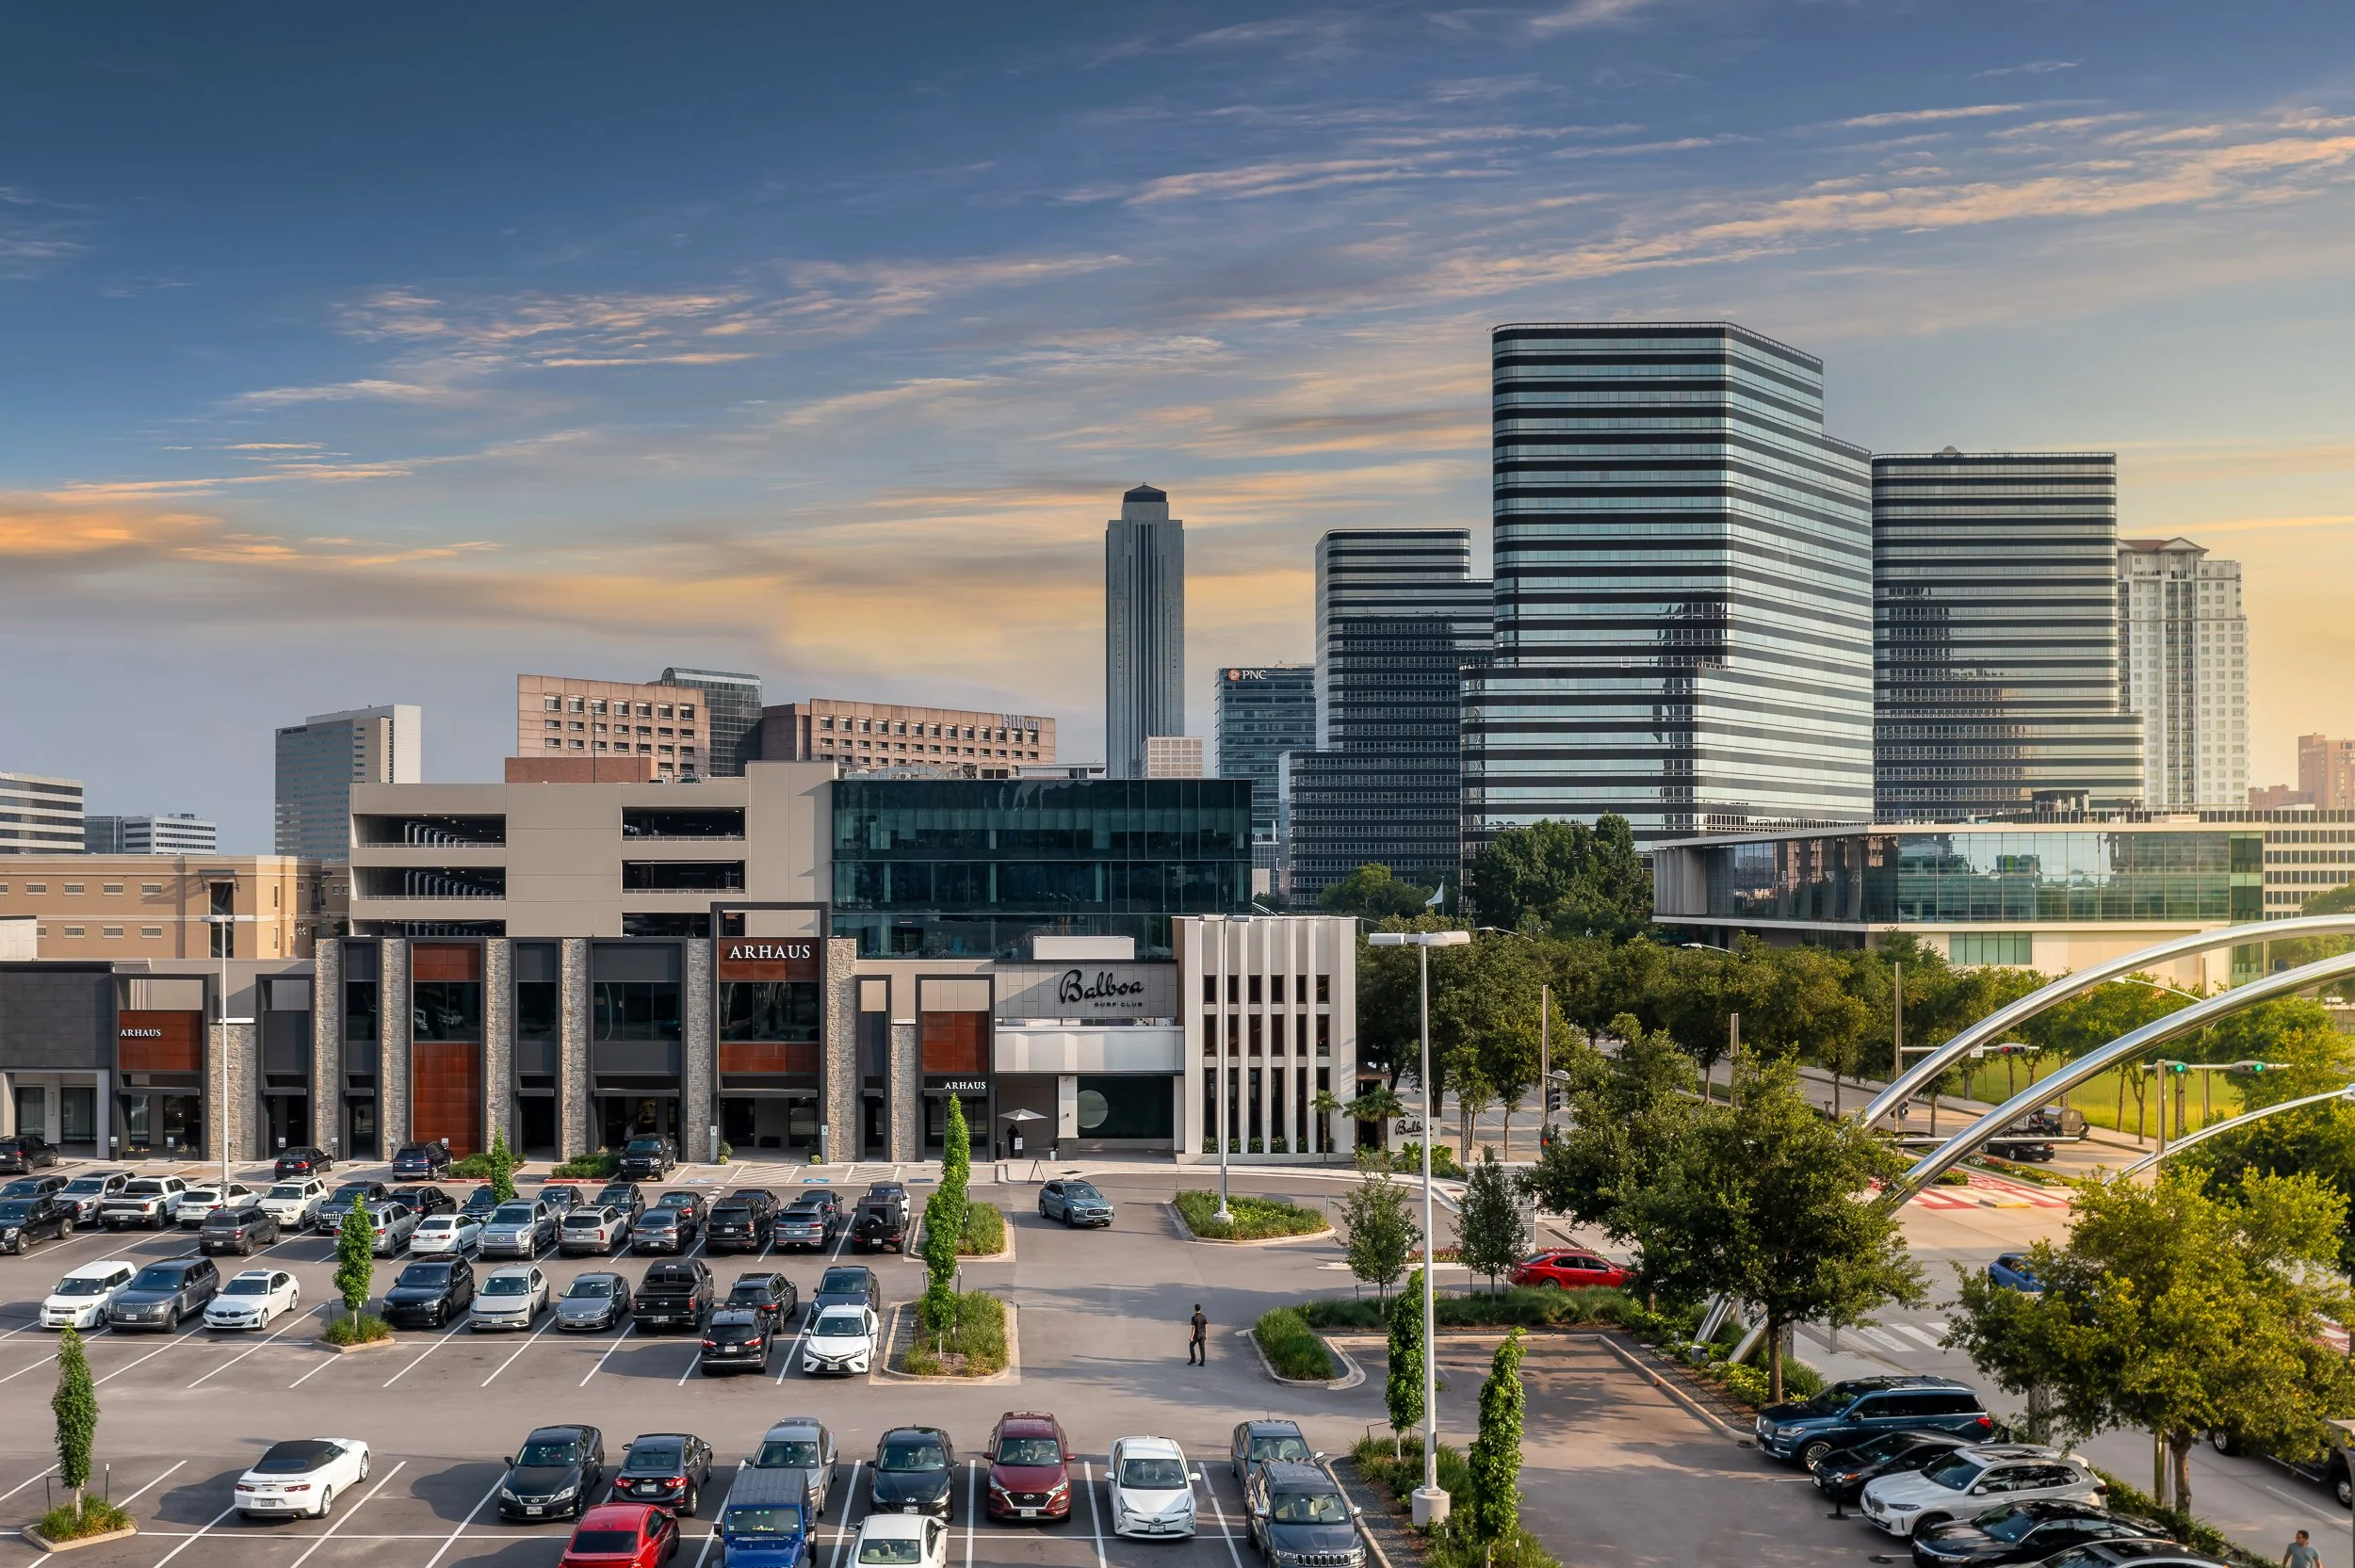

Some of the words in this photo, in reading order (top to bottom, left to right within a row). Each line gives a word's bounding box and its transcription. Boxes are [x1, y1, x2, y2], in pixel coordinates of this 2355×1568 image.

[1242, 670, 1267, 680] PNC
[1002, 714, 1038, 731] Hilton
[729, 945, 810, 959] ARHAUS
[1060, 969, 1145, 1004] Balboa
[120, 1028, 161, 1037] ARHAUS
[944, 1081, 986, 1090] ARHAUS
